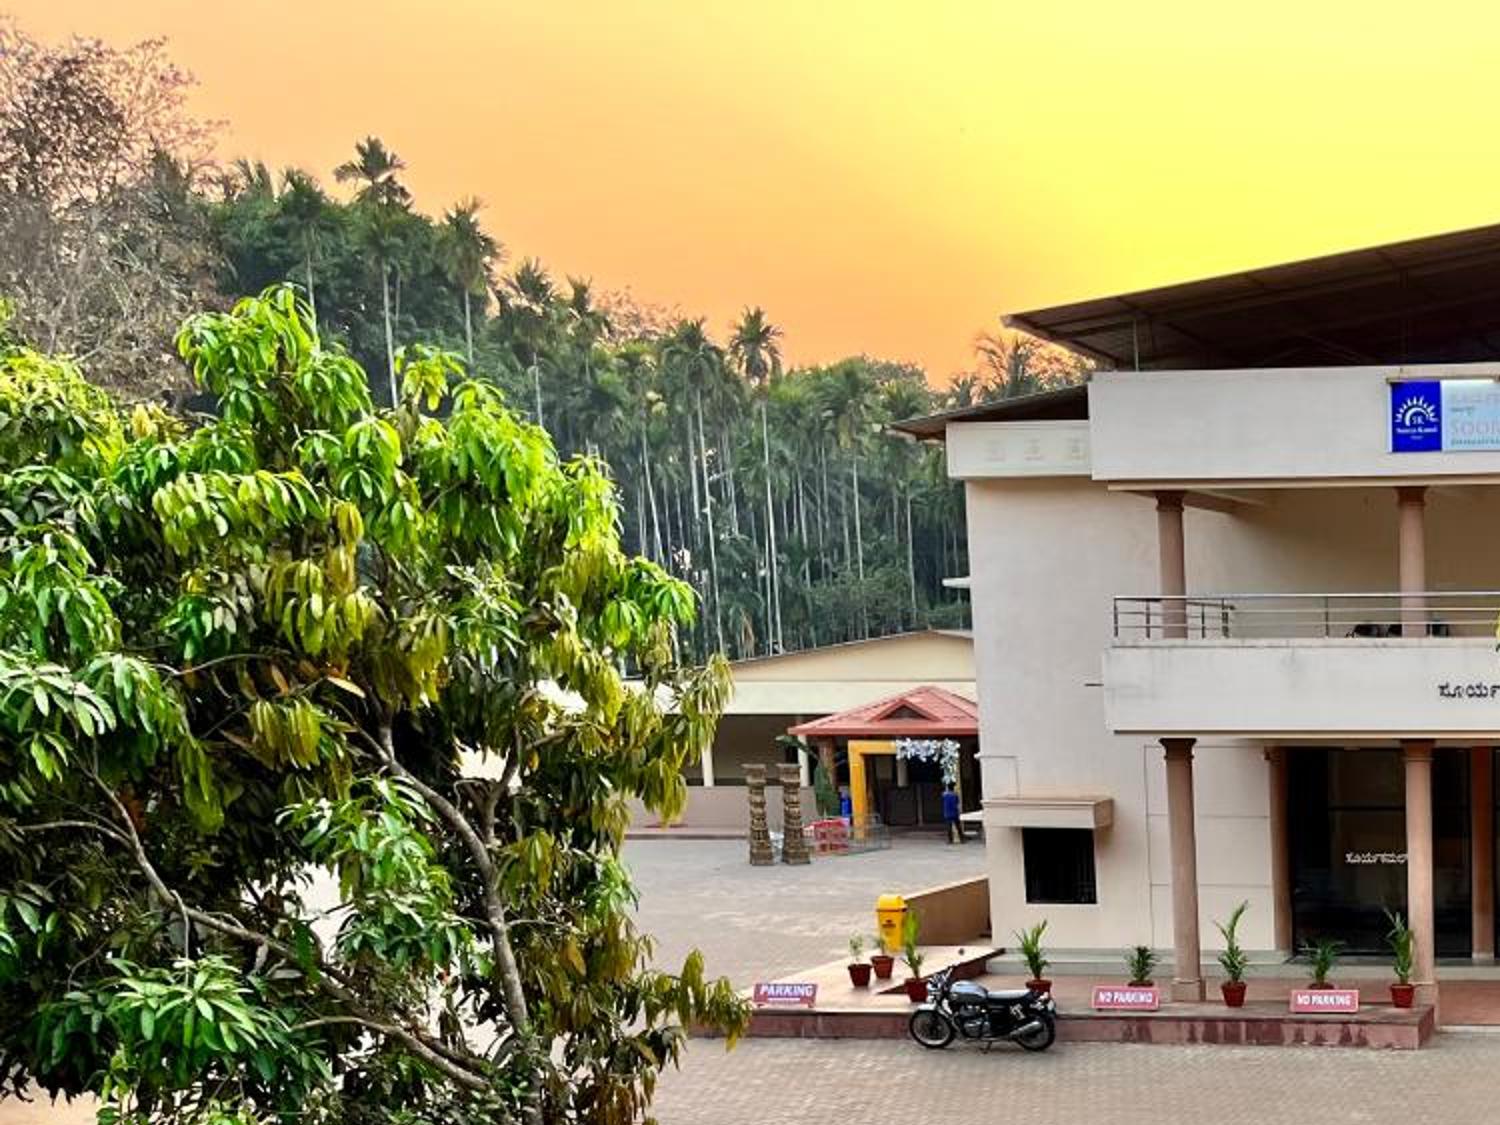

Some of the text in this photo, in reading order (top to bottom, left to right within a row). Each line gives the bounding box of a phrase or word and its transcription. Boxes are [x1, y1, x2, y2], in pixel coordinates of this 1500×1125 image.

[760, 985, 813, 997] PARKING
[1099, 991, 1153, 1003] NO PARKING
[1297, 994, 1352, 1006] NO PARKING
